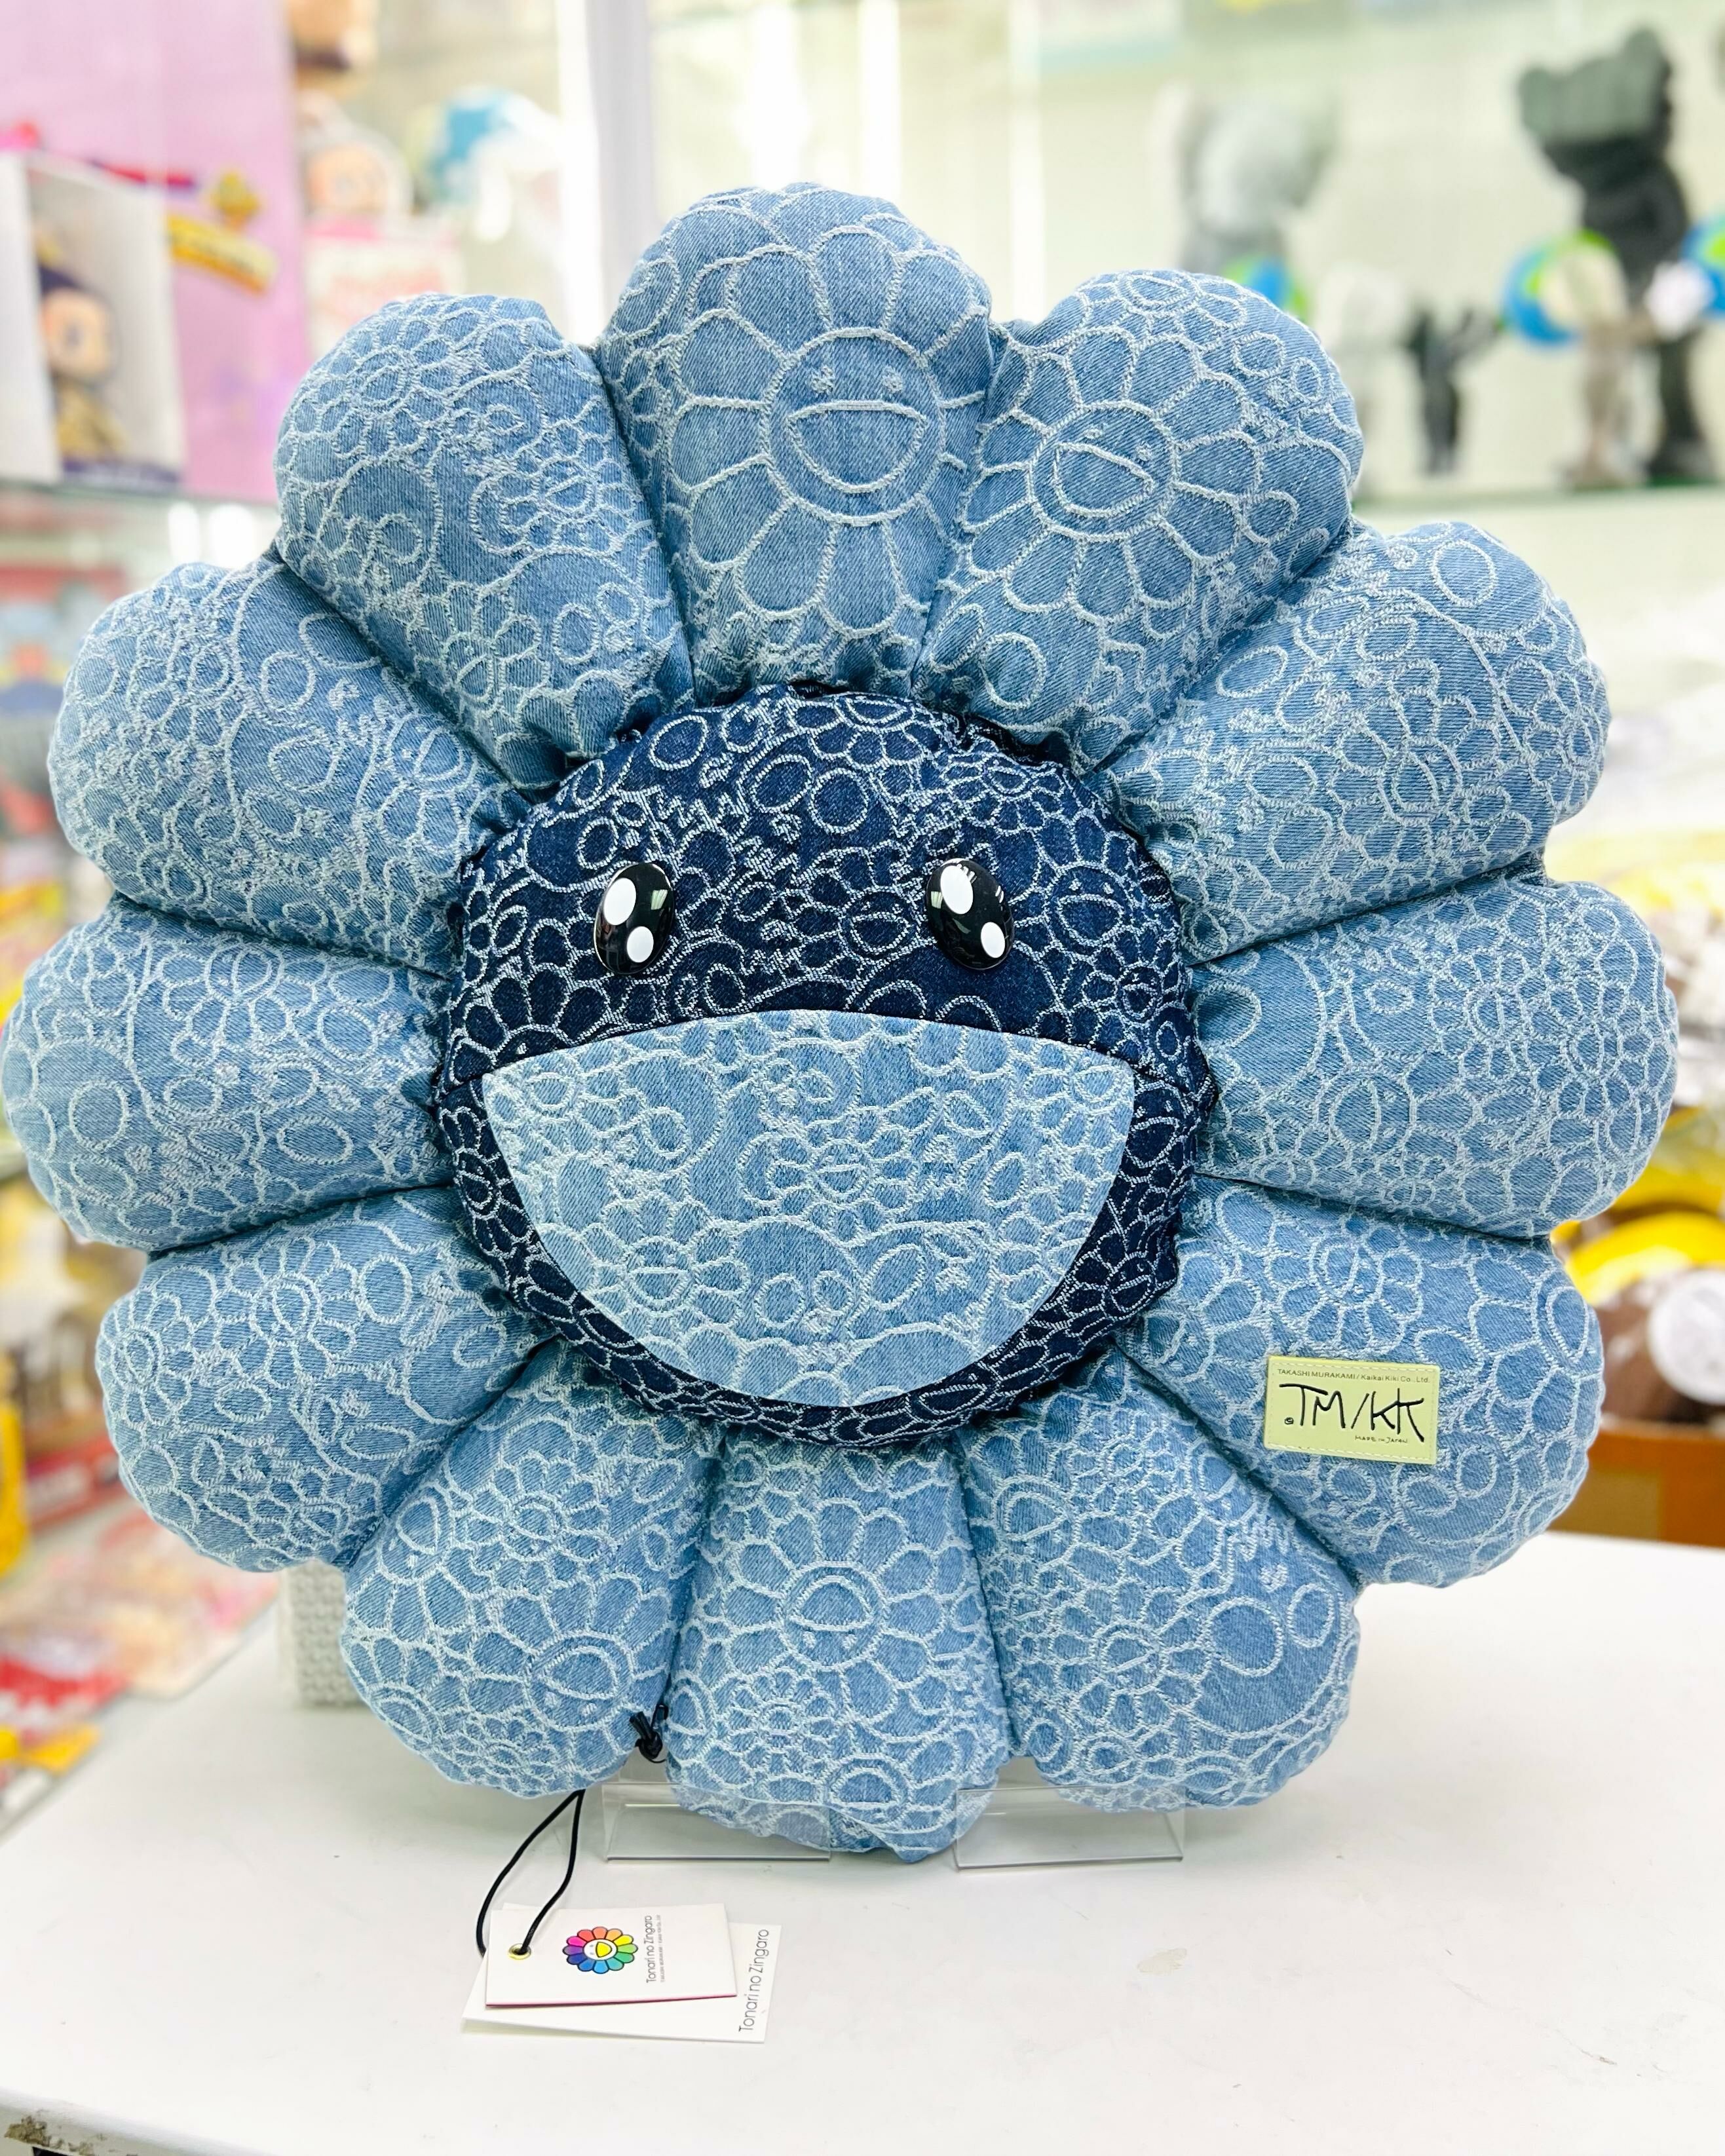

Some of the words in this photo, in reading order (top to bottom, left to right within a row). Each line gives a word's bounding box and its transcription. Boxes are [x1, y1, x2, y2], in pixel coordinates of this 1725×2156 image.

[1311, 1371, 1355, 1380] MURAKAMI
[643, 1915, 656, 1944] Zingaro
[646, 1945, 655, 1956] no
[748, 1929, 769, 1973] Zingaro
[645, 1957, 656, 1983] Tonari
[749, 1975, 762, 1992] no
[738, 1994, 759, 2032] Tonari
